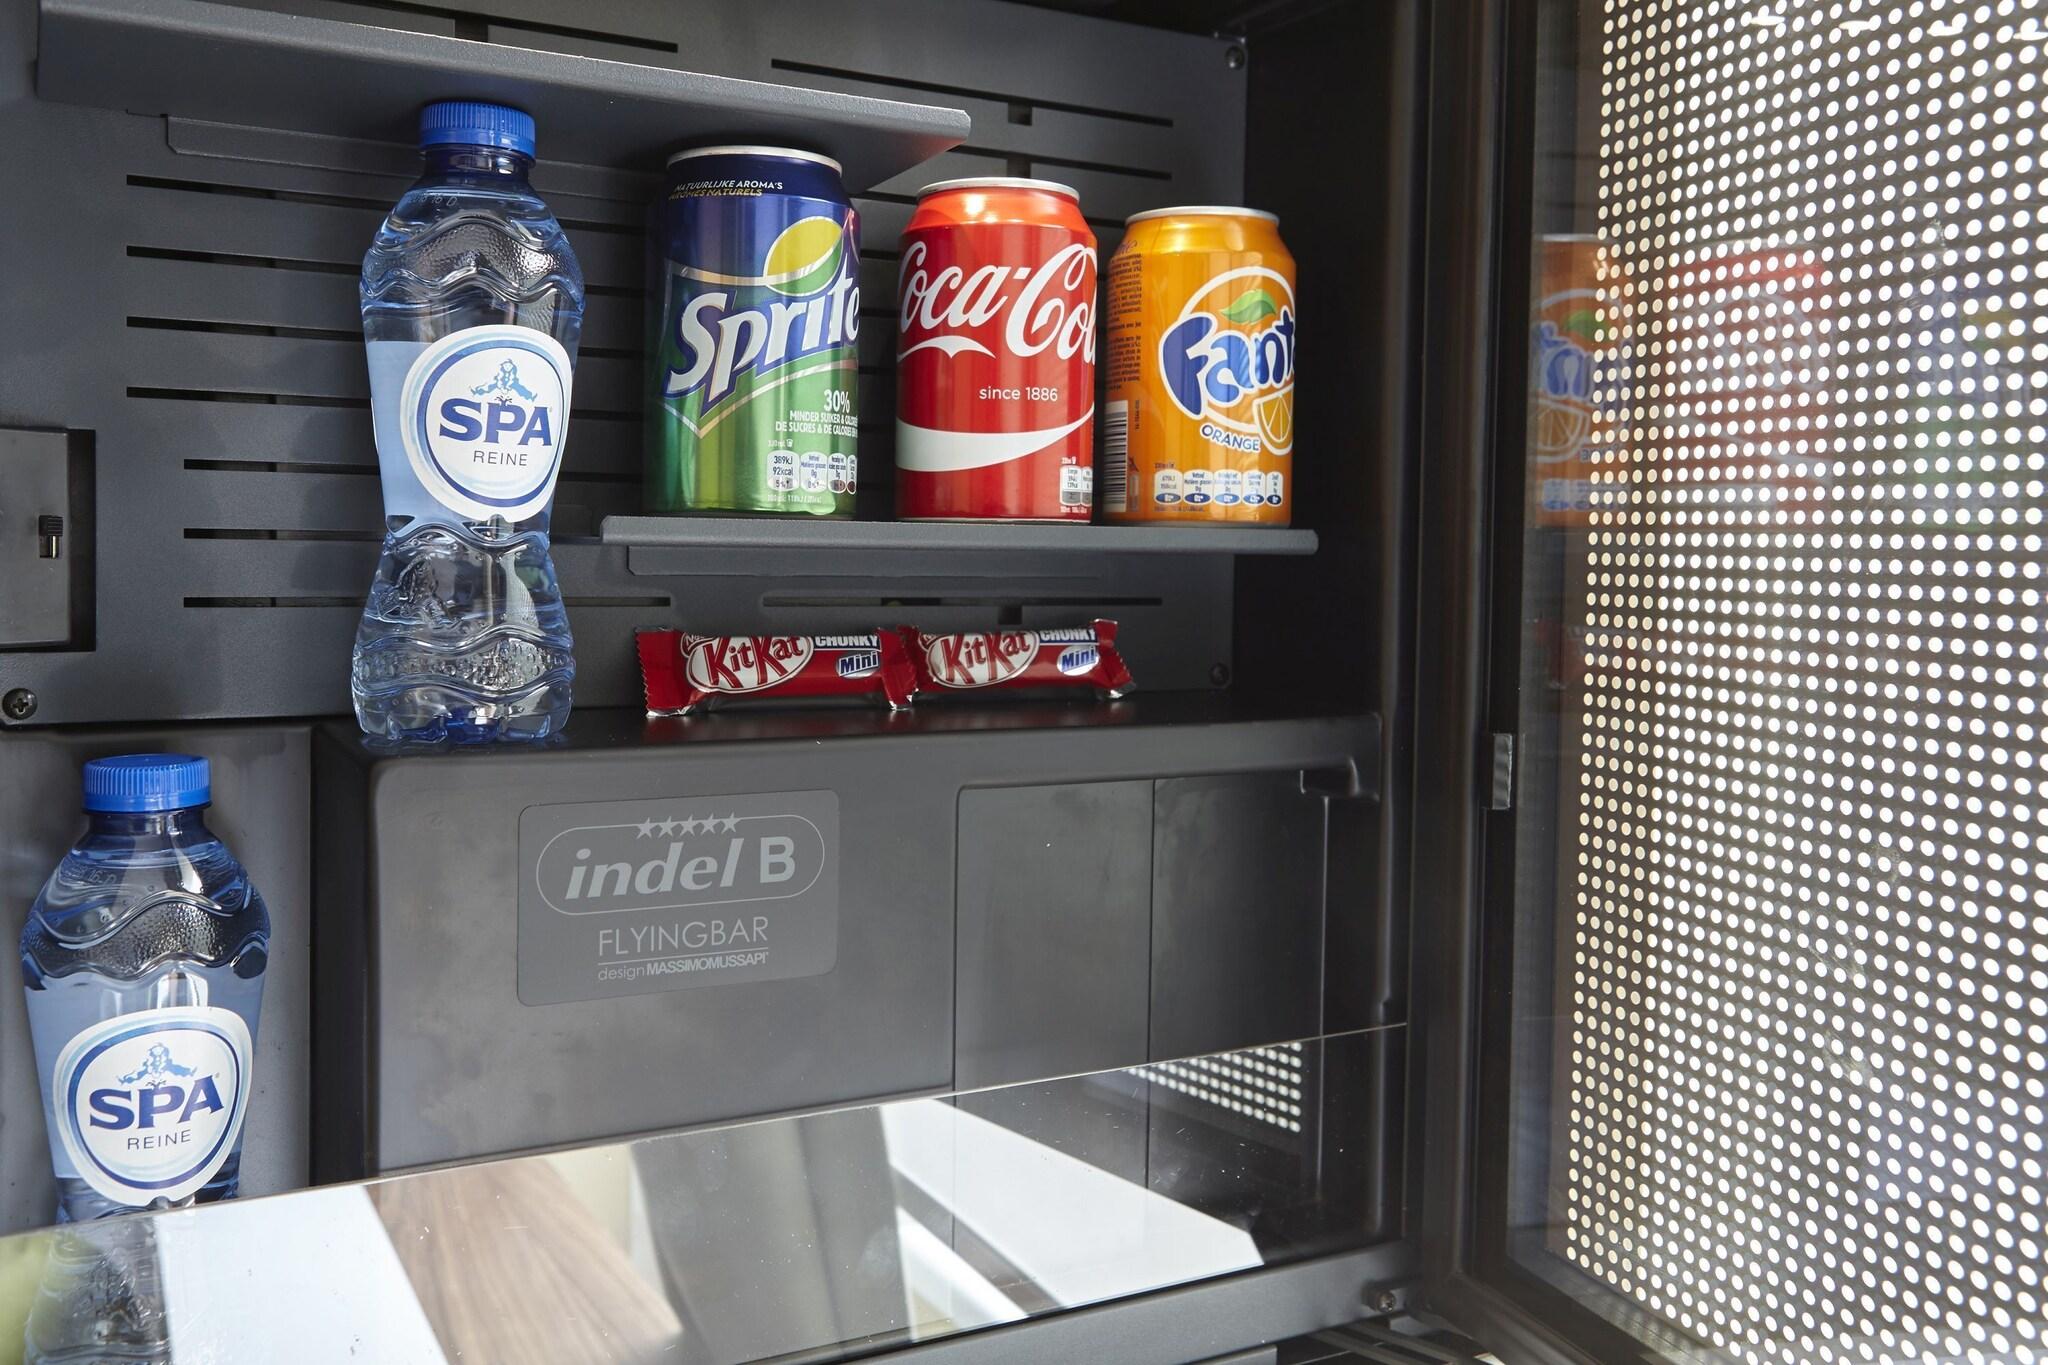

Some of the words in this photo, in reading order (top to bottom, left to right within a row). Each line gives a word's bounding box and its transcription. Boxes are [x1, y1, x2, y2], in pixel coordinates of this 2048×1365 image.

[707, 188, 763, 197] NATURELS
[736, 181, 783, 190] AROMA'S
[899, 241, 1097, 366] Coca-Col
[667, 253, 860, 402] Sprite
[1159, 306, 1296, 418] Fant
[823, 388, 851, 413] 30%
[979, 386, 1021, 400] since
[1025, 387, 1058, 401] 1886
[440, 397, 552, 446] SPA
[775, 421, 787, 431] DE
[788, 421, 816, 433] SUCRES
[823, 424, 833, 434] DE
[789, 410, 819, 422] MINDER
[1200, 423, 1261, 453] ORANGE
[473, 450, 528, 467] REINE
[814, 635, 879, 647] CHUNKY
[702, 636, 804, 688] KitKat
[840, 652, 878, 675] Mini
[940, 632, 1031, 684] KitKat
[1061, 647, 1096, 671] Mini
[564, 836, 745, 900] indel
[759, 836, 796, 884] B
[599, 916, 769, 957] FLYINGBAR
[598, 964, 645, 981] design
[646, 952, 767, 976] MASSIMOMUSSAPI
[89, 1075, 224, 1130] SPA
[127, 1129, 192, 1150] REINE
